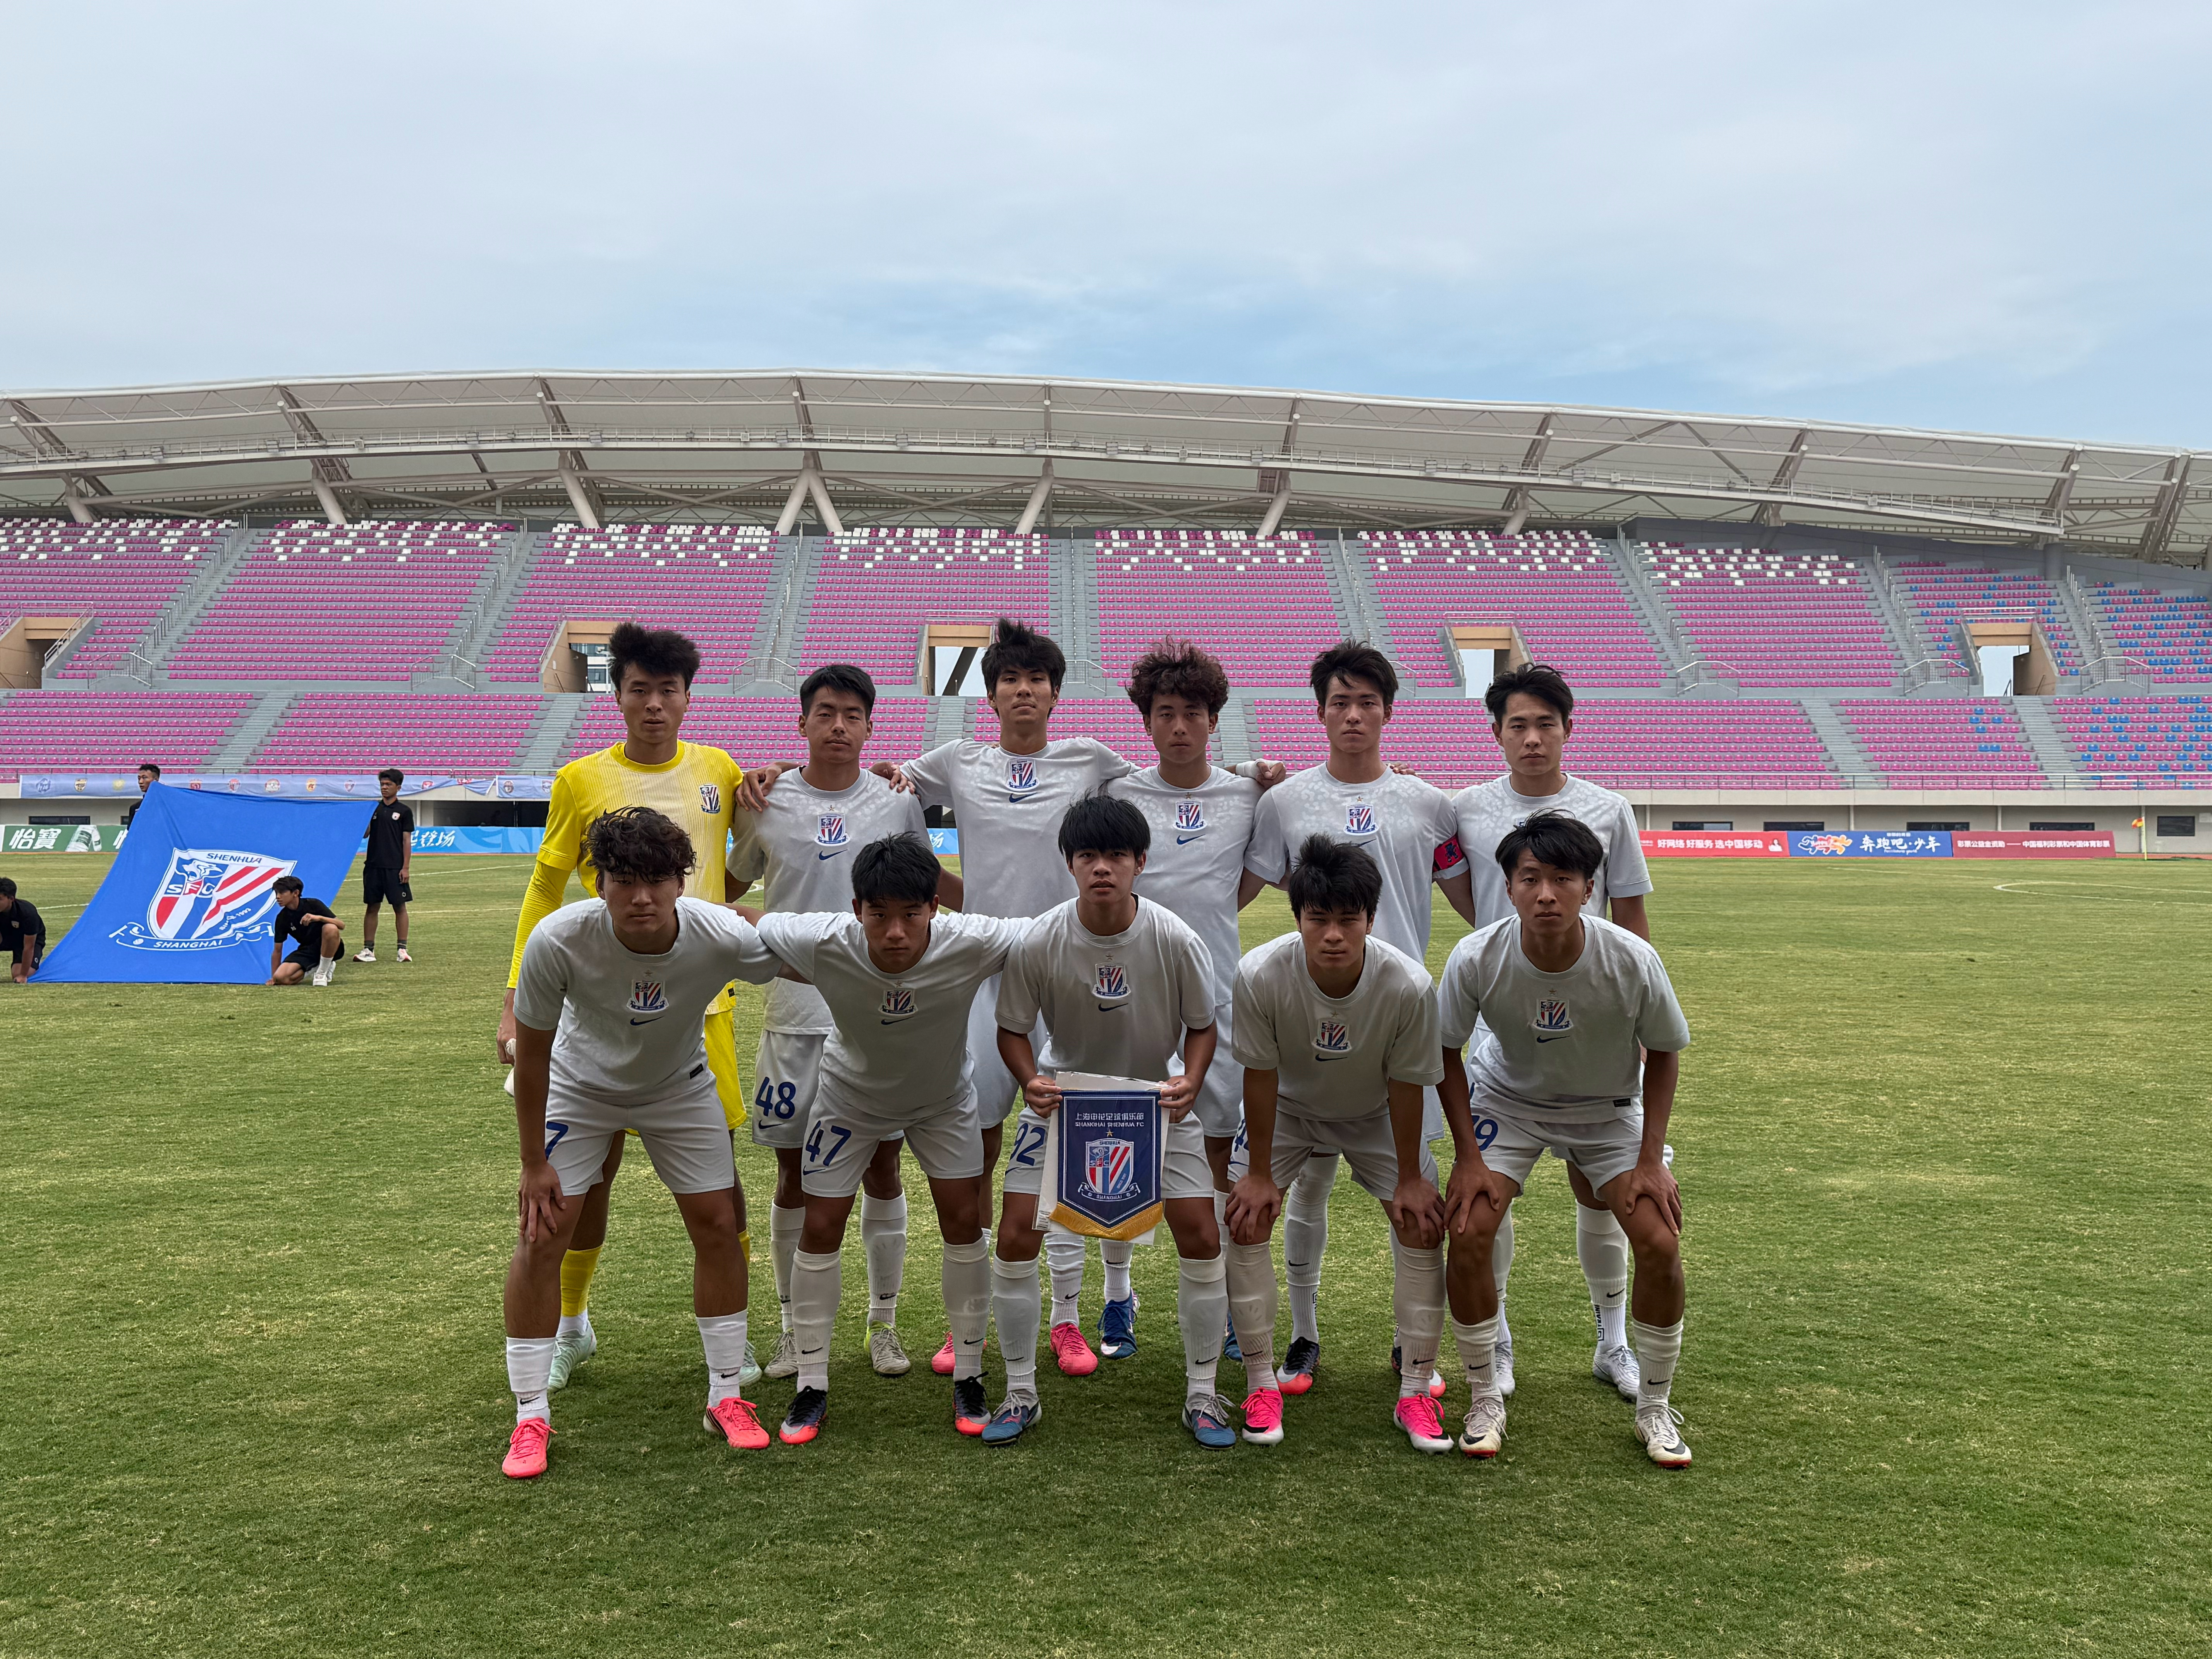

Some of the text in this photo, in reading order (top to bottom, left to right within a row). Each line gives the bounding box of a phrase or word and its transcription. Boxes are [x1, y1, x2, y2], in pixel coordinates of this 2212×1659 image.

[1657, 839, 1685, 848] 好网络
[1714, 839, 1763, 848] 选中国移动
[206, 853, 262, 864] SHENHUA
[153, 939, 223, 948] SHANGHAI
[755, 1077, 796, 1120] 48
[805, 1120, 852, 1166] 47
[1010, 1123, 1046, 1166] 92
